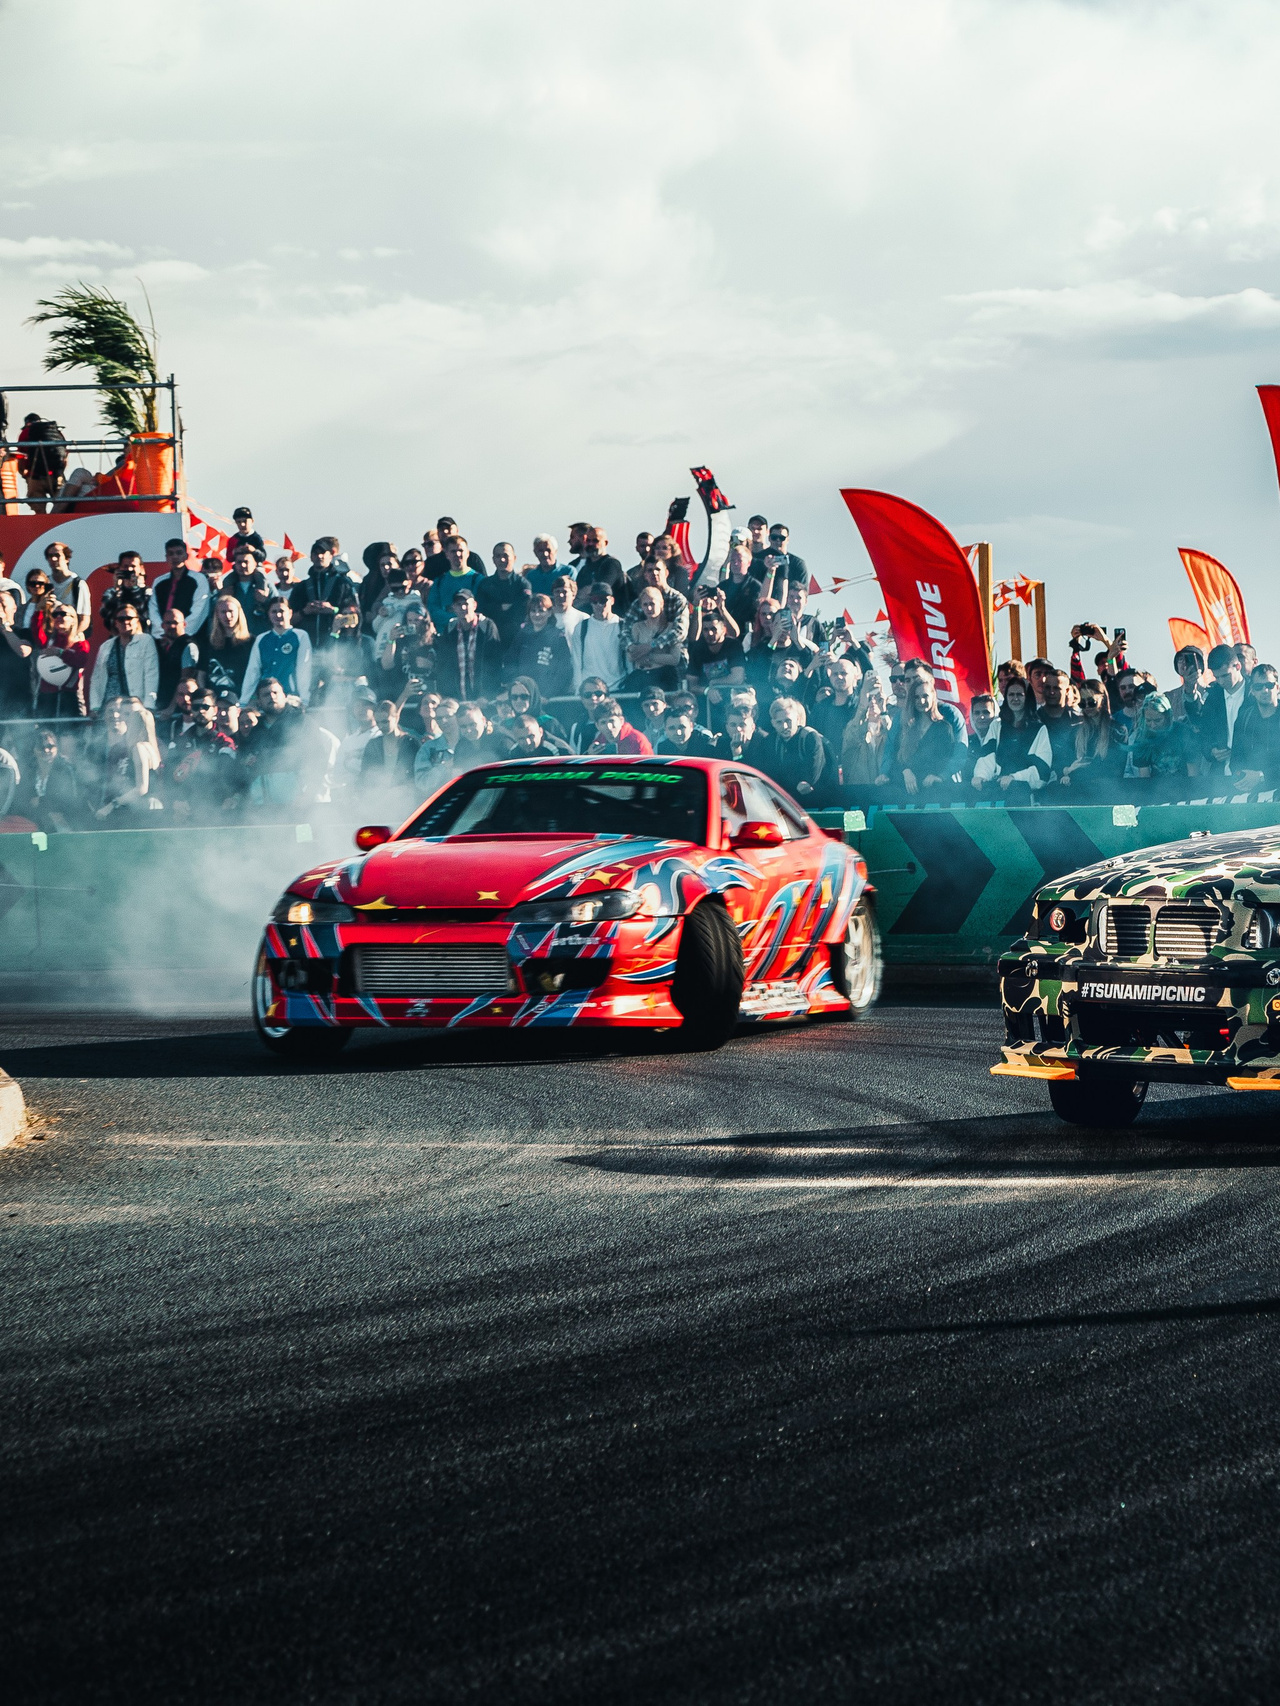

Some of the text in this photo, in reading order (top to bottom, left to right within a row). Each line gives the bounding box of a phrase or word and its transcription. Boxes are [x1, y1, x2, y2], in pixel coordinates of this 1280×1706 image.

[485, 771, 683, 784] TSUNAMI PICNIC
[1081, 982, 1206, 1002] #TSUNAMIPICNIC
